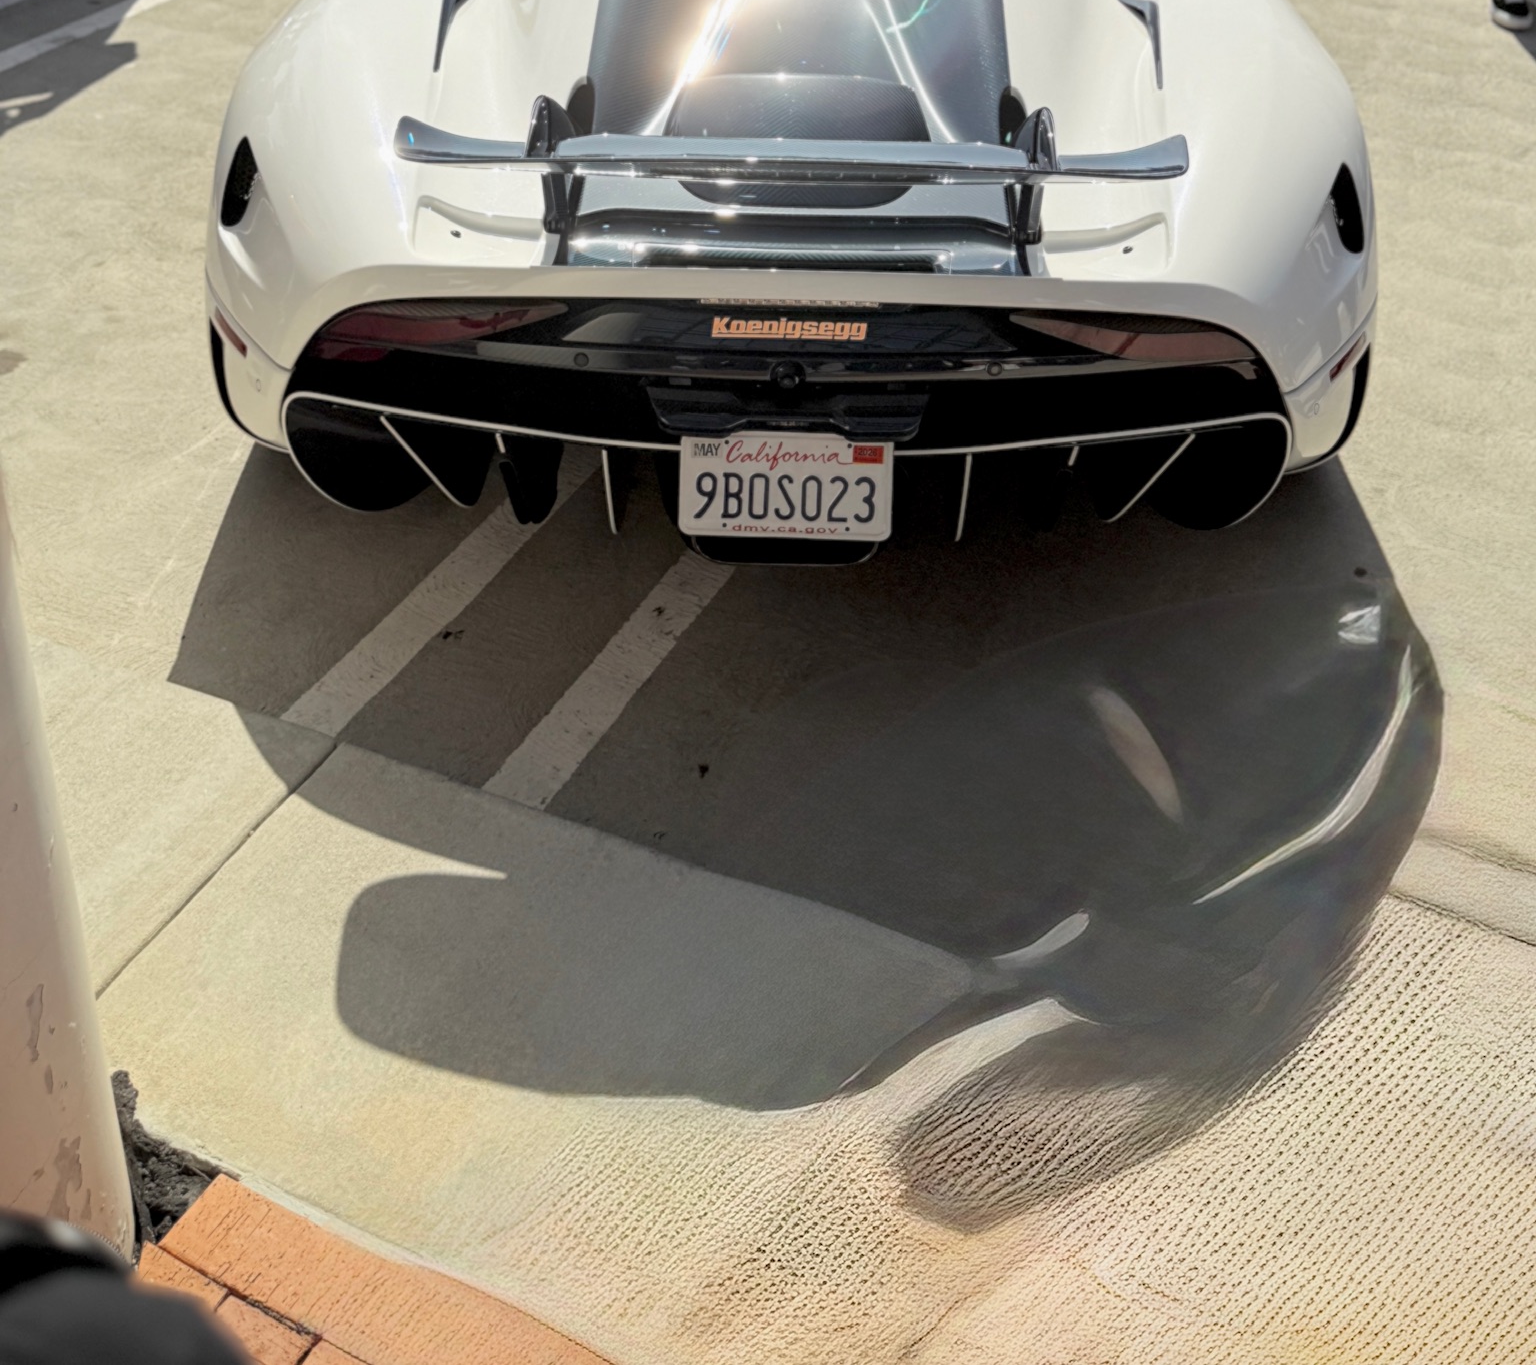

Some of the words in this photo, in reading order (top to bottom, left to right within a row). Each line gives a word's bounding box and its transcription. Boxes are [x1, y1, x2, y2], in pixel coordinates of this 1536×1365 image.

[711, 317, 867, 340] Koenigsegg
[694, 443, 721, 457] MAY
[726, 440, 854, 471] California
[732, 523, 838, 535] dmv.ca.gov
